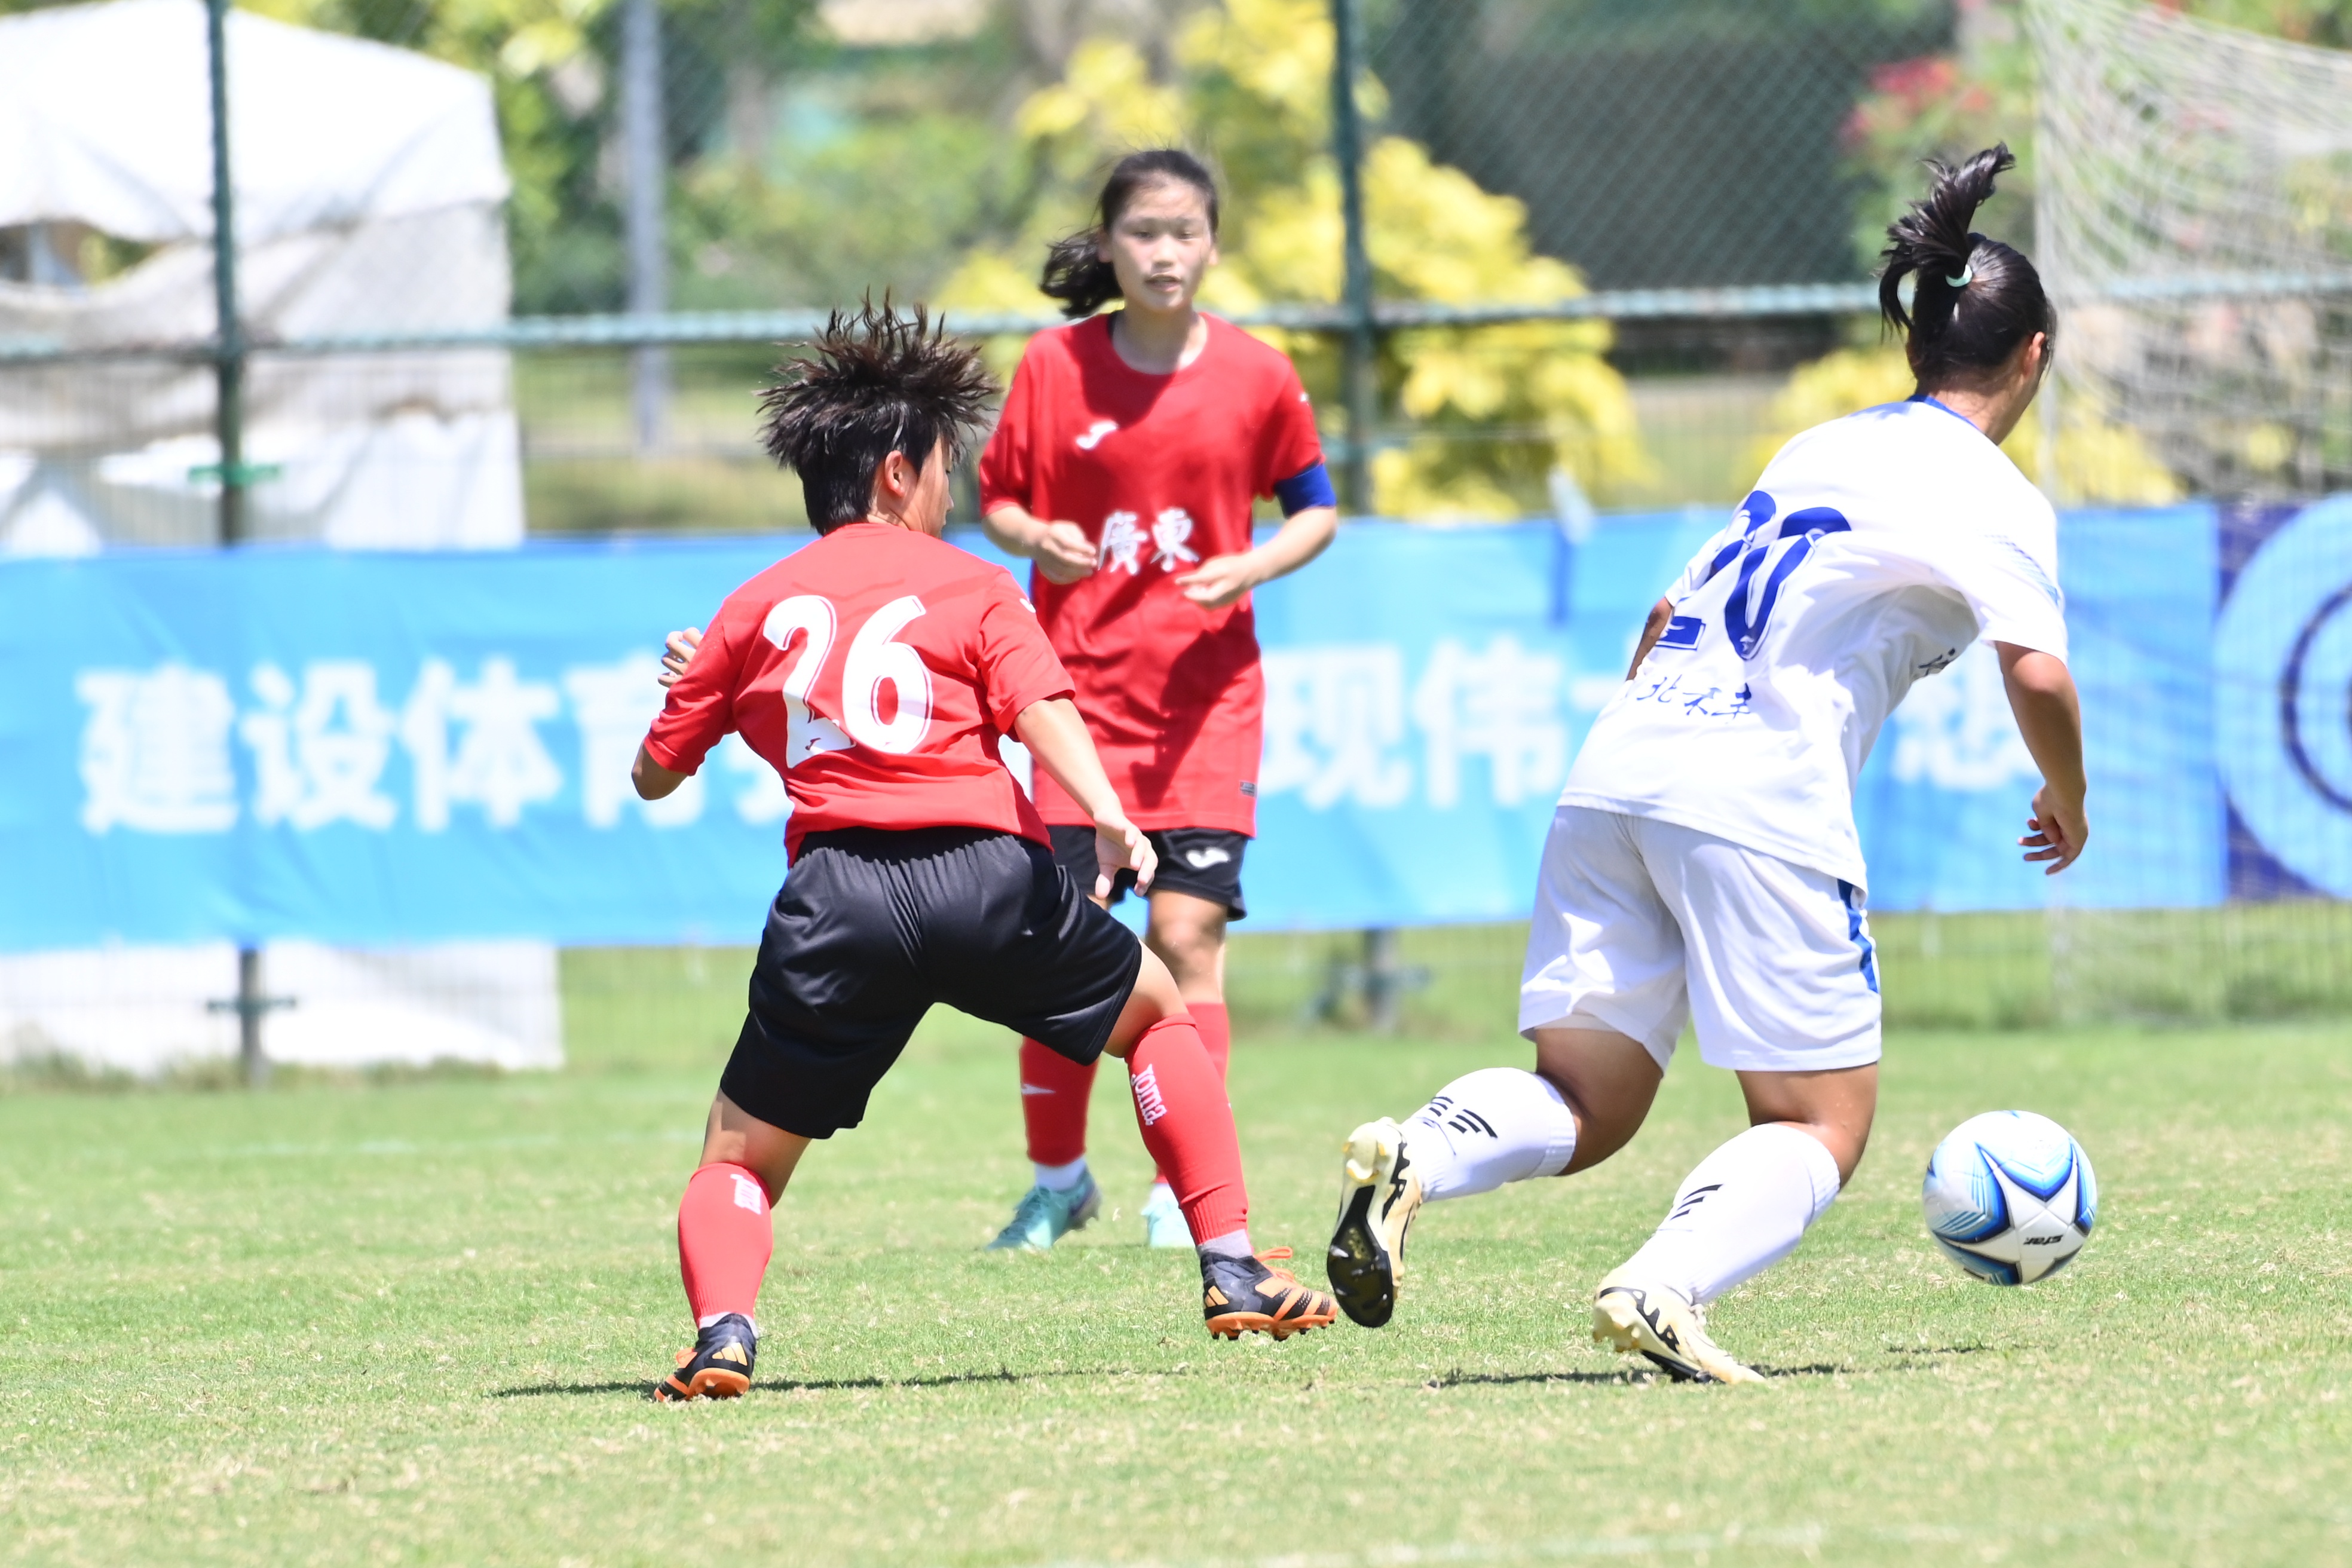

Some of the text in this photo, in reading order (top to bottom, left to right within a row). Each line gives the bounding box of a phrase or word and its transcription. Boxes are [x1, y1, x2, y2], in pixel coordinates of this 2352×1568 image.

[1097, 509, 1200, 574] 廣東
[74, 648, 791, 834] 建设体育
[763, 595, 933, 769] 26
